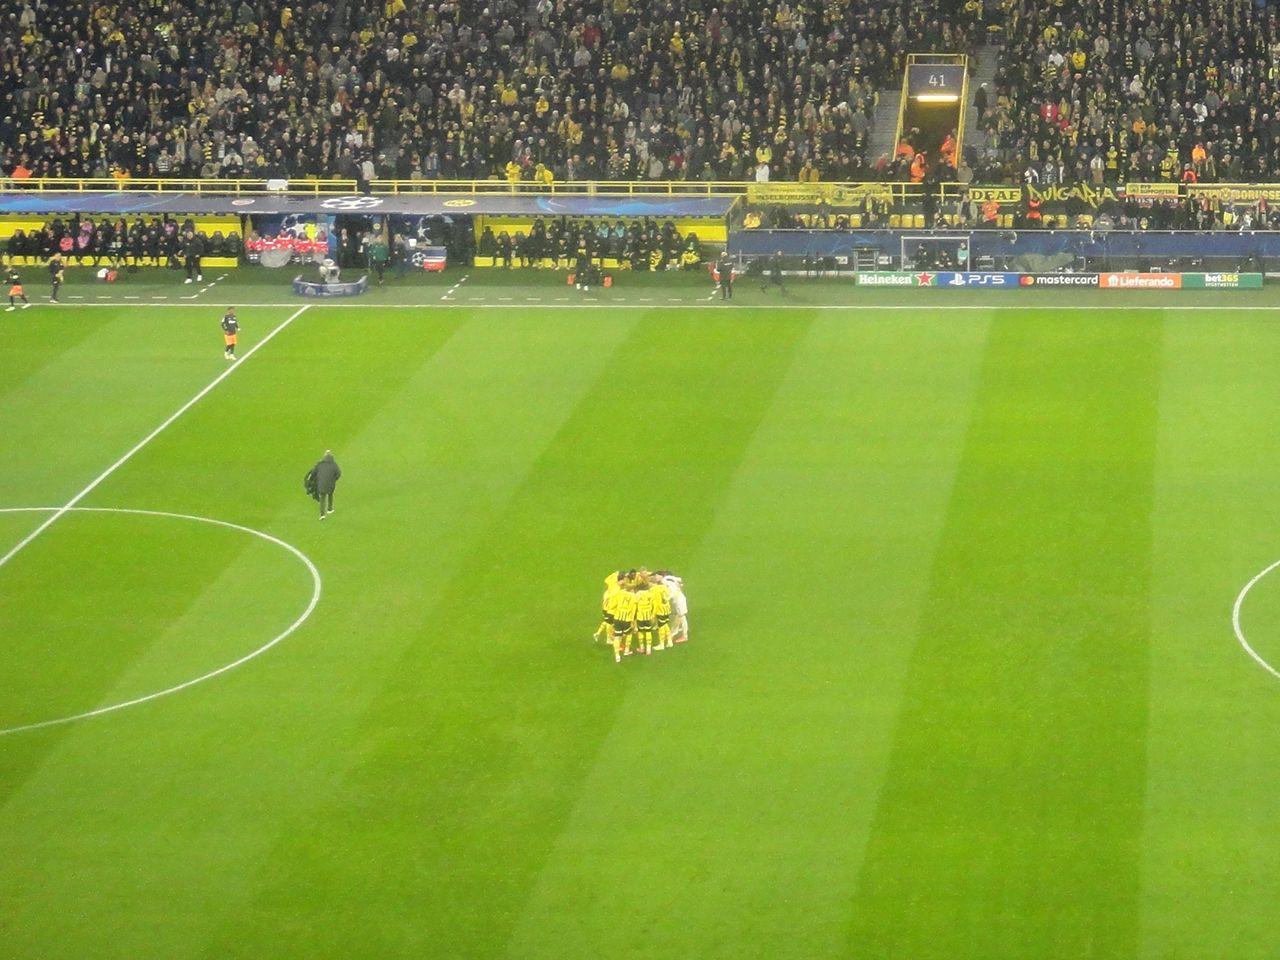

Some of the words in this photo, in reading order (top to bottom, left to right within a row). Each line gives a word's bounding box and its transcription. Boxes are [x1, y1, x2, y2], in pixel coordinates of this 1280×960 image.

[928, 74, 946, 87] 41
[858, 273, 913, 284] Heineken
[968, 274, 1005, 284] PS5
[1036, 275, 1098, 286] mastercard
[1120, 276, 1174, 287] Lieferando
[1204, 273, 1239, 283] bet365
